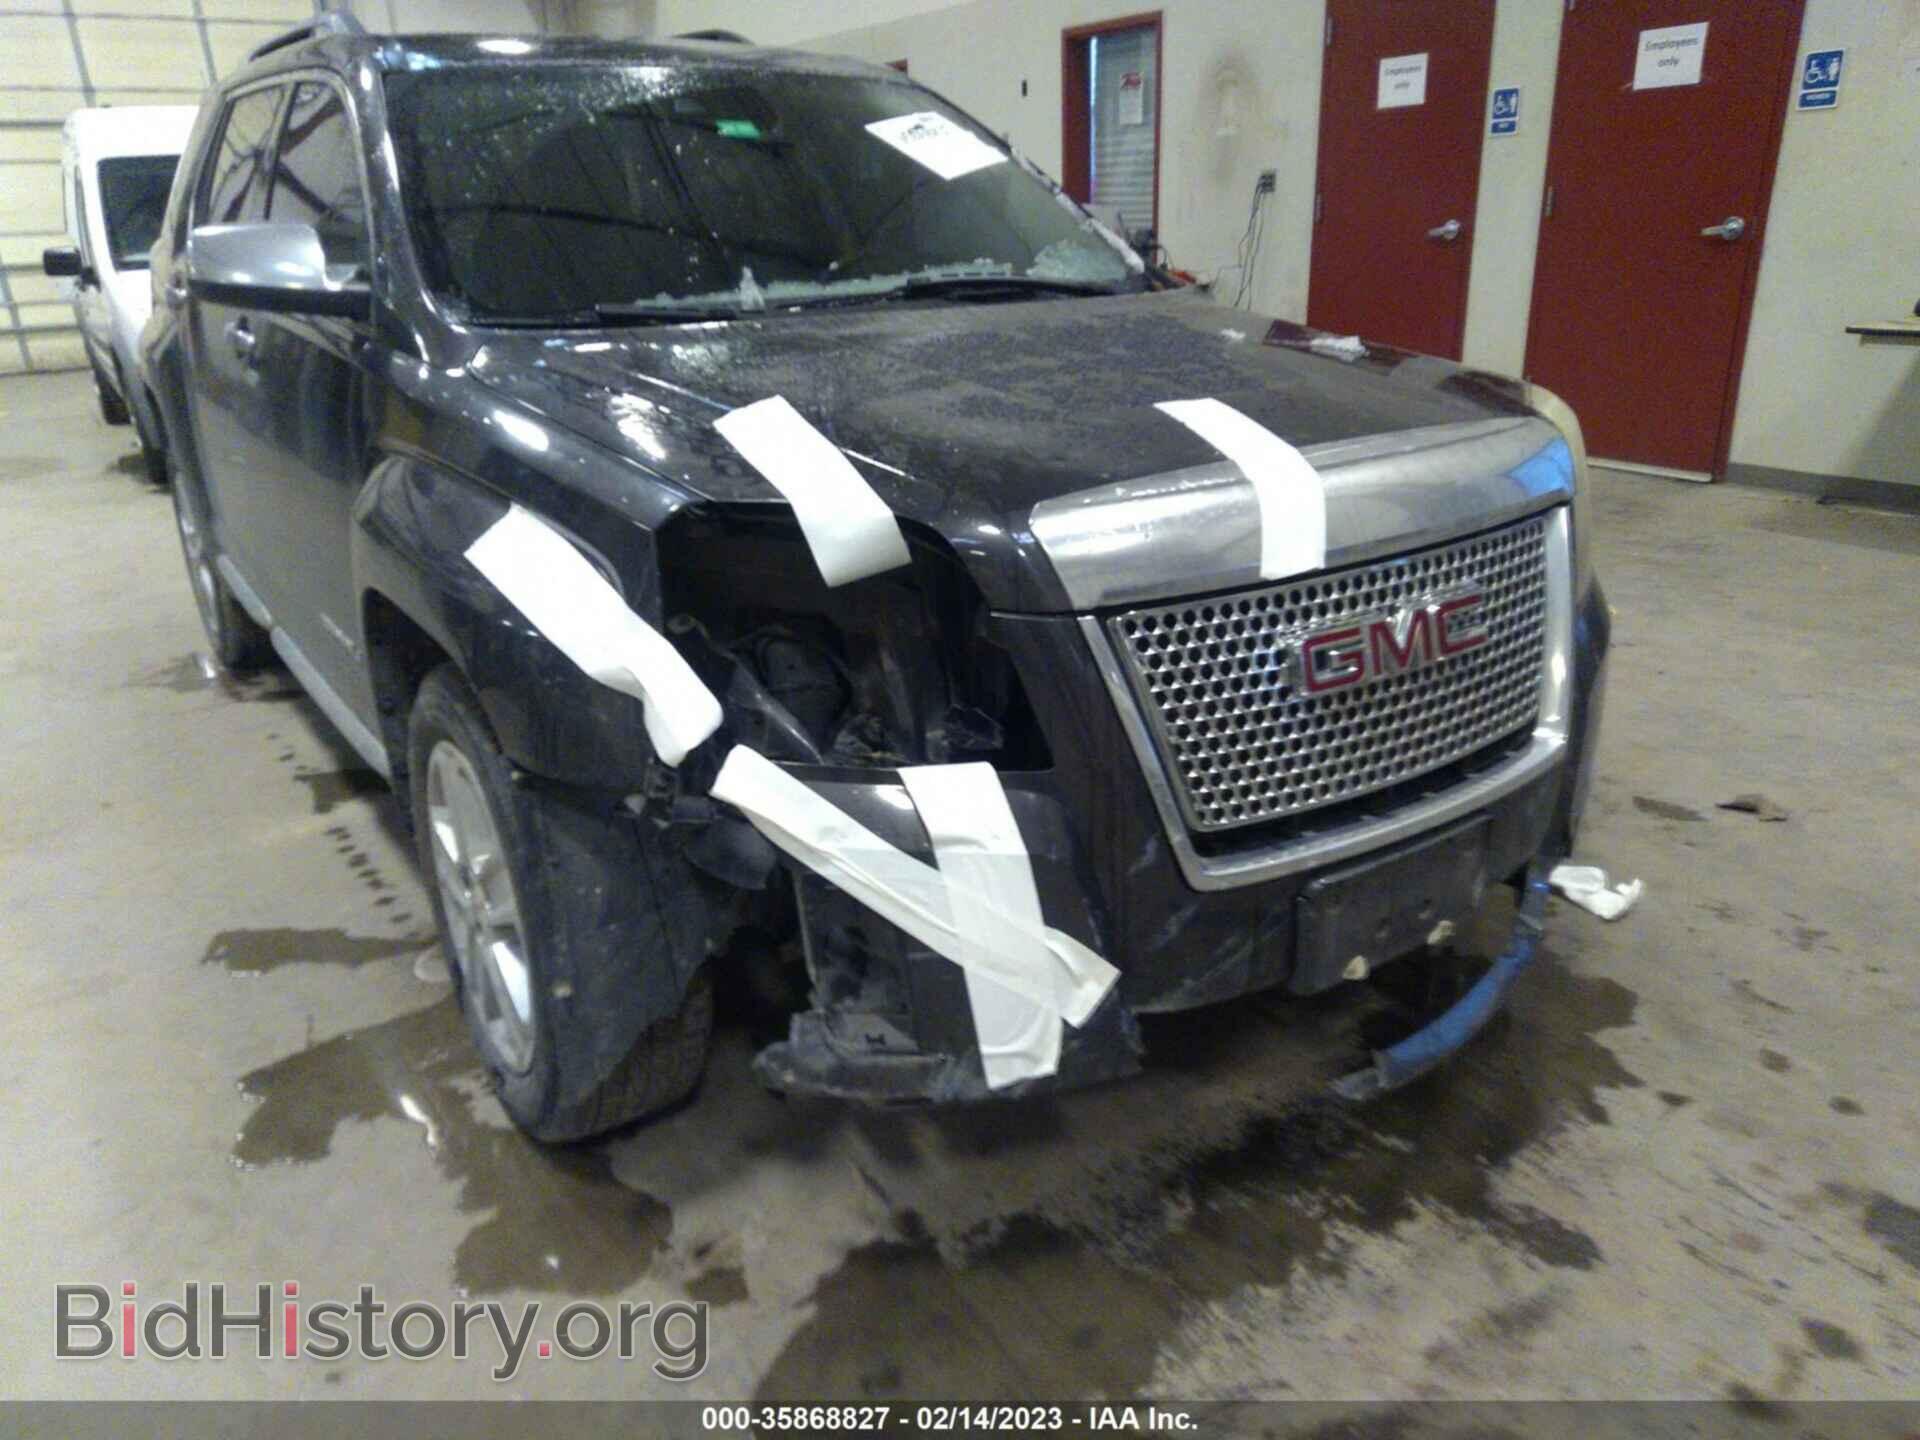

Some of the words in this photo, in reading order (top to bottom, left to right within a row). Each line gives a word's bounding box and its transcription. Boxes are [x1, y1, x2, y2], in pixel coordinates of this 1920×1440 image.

[1645, 36, 1699, 52] Employees
[1657, 56, 1679, 68] only
[1302, 594, 1489, 692] GMC
